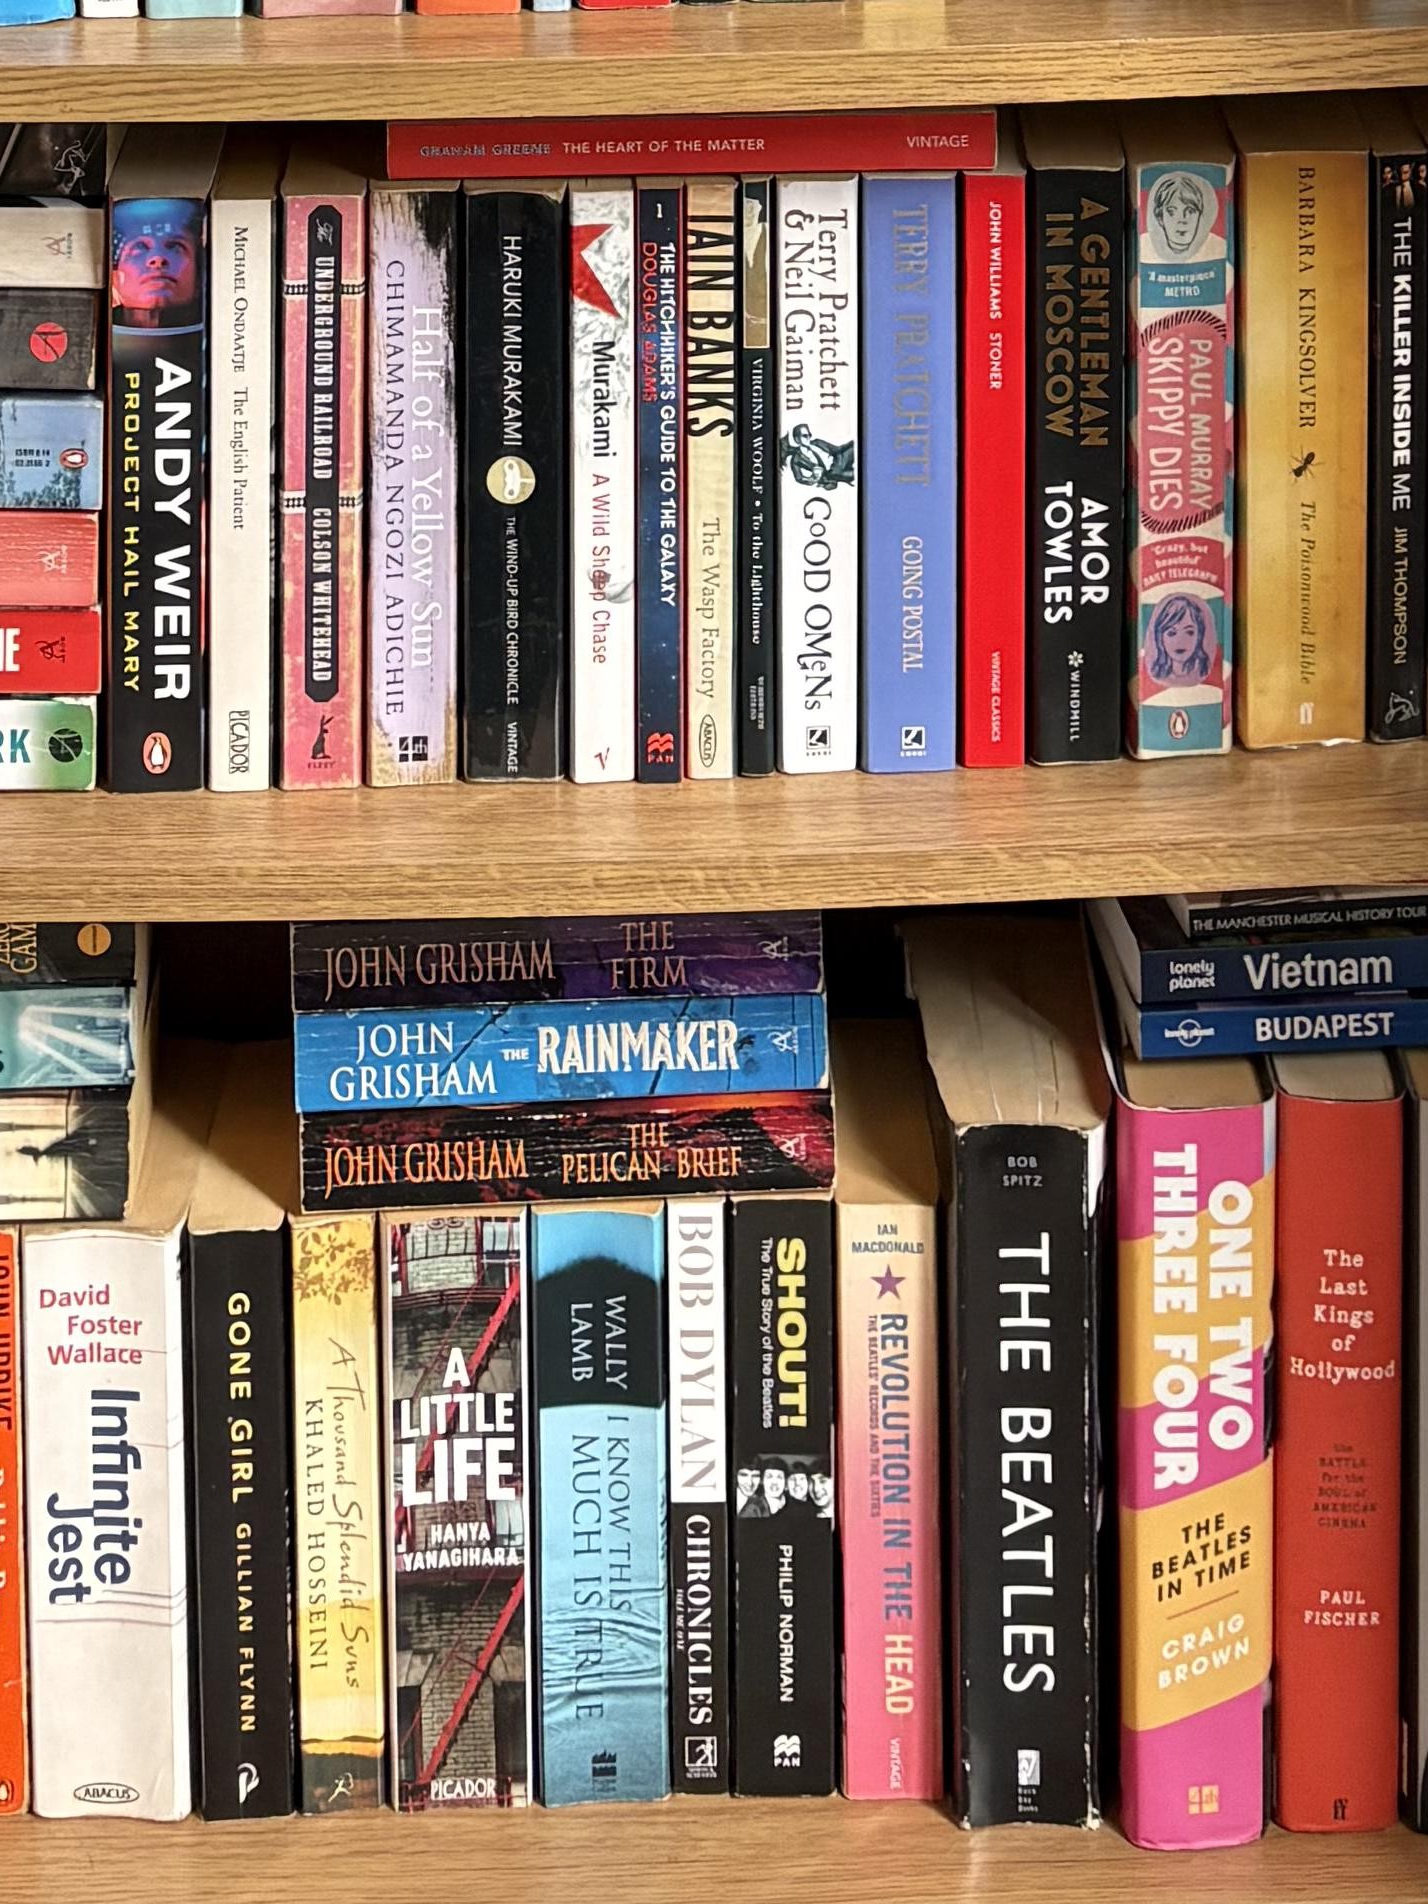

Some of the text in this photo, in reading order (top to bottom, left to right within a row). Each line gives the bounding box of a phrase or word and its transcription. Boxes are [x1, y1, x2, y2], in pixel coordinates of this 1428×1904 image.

[563, 137, 764, 155] THE HEART OF THE MATTER
[989, 201, 1002, 390] JOHN WILLIAMS STONER
[124, 372, 140, 693] PROJECT HAIL MARY
[153, 357, 192, 701] ANDY WEIR
[1044, 481, 1073, 624] TOWLES
[1078, 497, 1109, 604] AMOR
[902, 536, 924, 671] GOING POSTAL
[1244, 952, 1393, 991] Vietnam
[357, 1022, 453, 1063] JOHN
[537, 1020, 739, 1074] RAINMAKER
[1255, 1010, 1394, 1043] BUDAPEST
[329, 1062, 497, 1102] GRISHAM
[39, 1285, 110, 1308] David
[67, 1316, 143, 1337] Foster
[47, 1342, 143, 1365] Wallace
[774, 1236, 807, 1428] SHOUT!
[441, 1347, 470, 1390] A
[400, 1393, 515, 1439] LITTLE
[91, 1389, 143, 1585] Infinite
[401, 1438, 516, 1505] LIFE
[998, 1232, 1055, 1695] THE BEATLES
[45, 1492, 92, 1605] Jest
